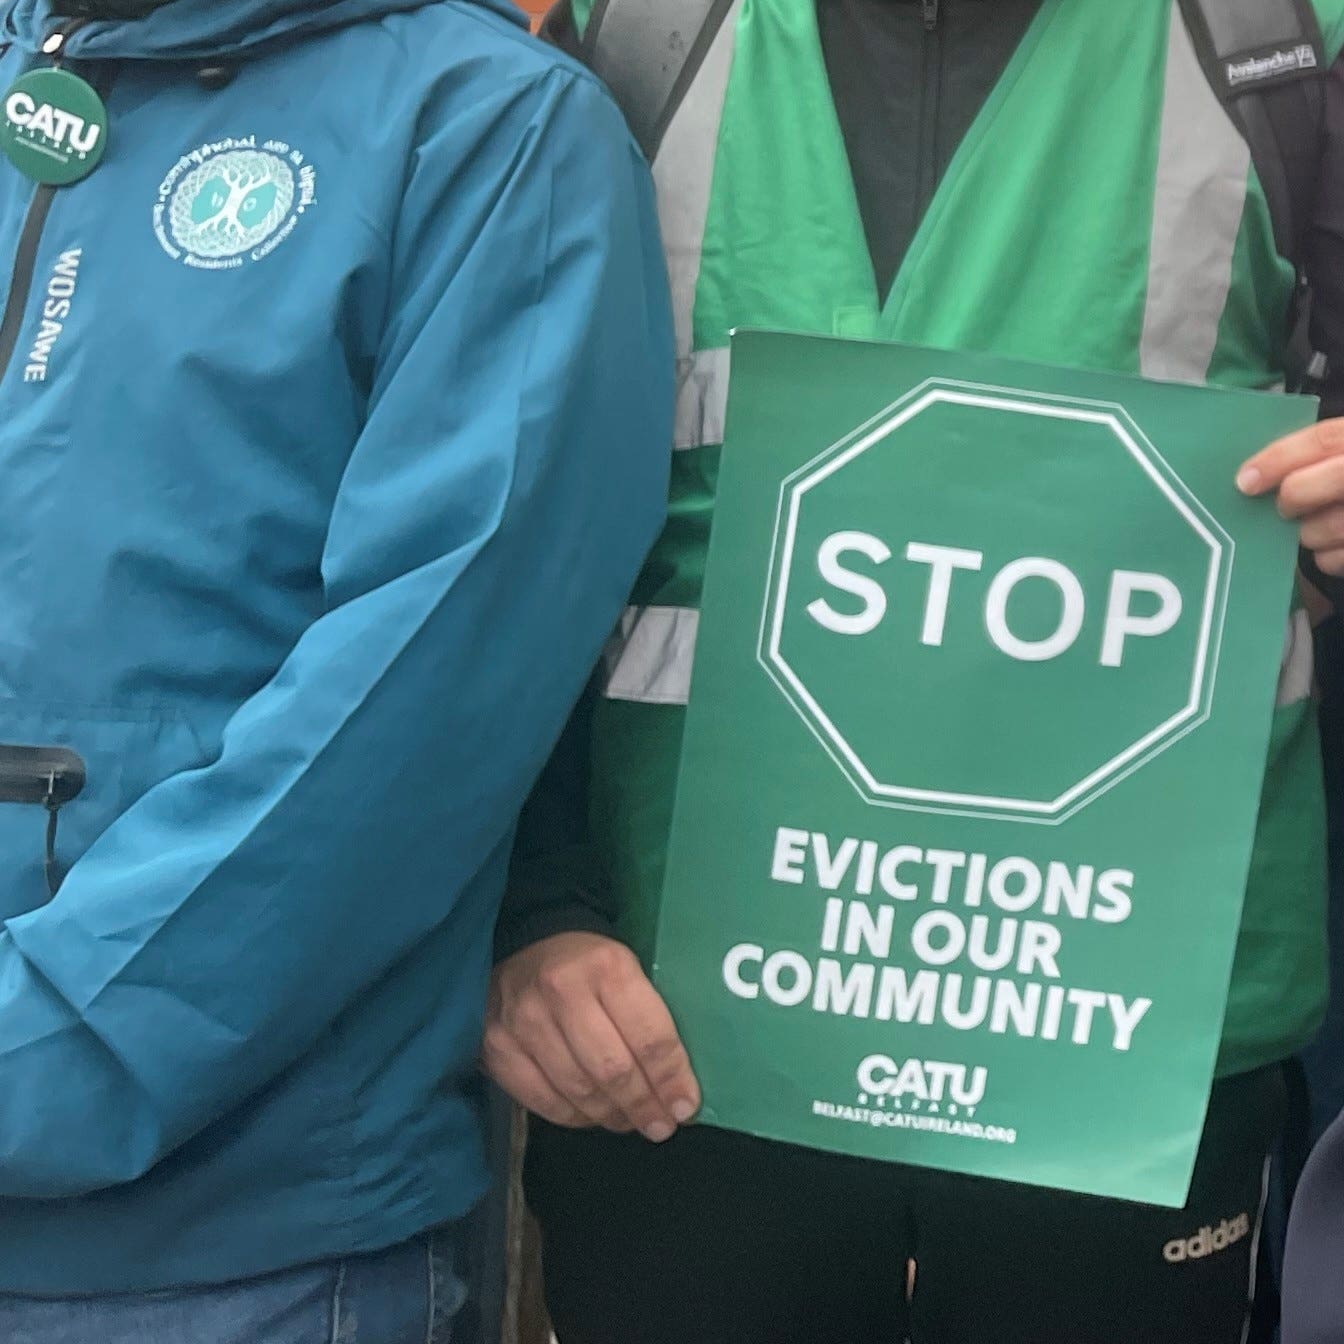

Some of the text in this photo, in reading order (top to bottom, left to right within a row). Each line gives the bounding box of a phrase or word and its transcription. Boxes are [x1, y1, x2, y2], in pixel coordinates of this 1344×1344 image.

[6, 92, 100, 152] CATU
[24, 248, 82, 383] WOSAWE
[806, 530, 1183, 667] STOP
[771, 826, 1135, 923] EVICTIONS
[821, 897, 1062, 978] IN OUR
[722, 942, 1153, 1051] COMMUNITY
[857, 1054, 988, 1105] CATU
[1163, 1213, 1249, 1263] adidas
